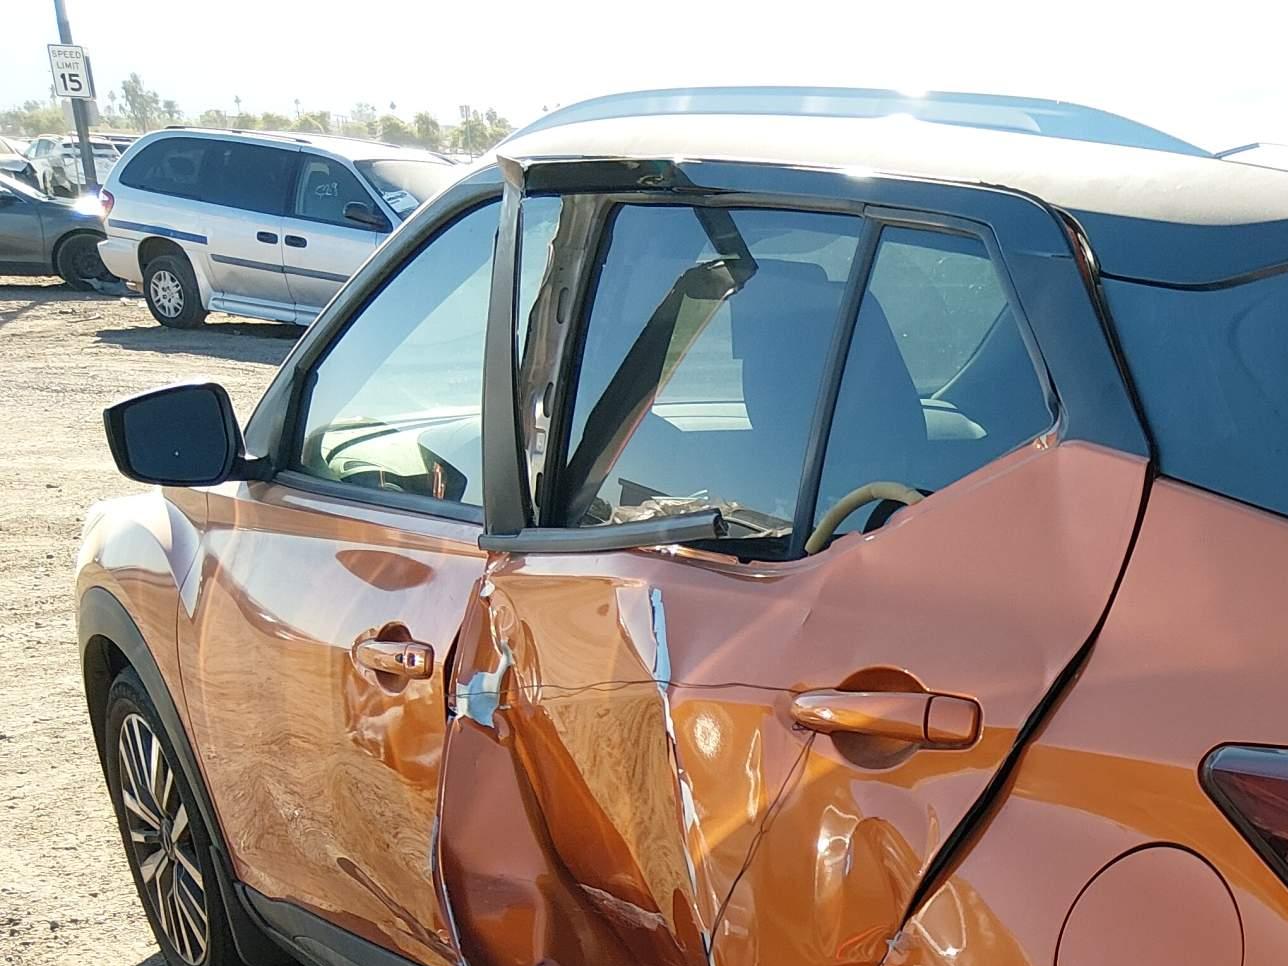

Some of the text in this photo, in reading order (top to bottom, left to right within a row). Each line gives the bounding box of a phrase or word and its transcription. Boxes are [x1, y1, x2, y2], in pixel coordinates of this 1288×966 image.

[52, 50, 81, 59] SPEED
[56, 61, 80, 70] LIMIT
[60, 72, 82, 92] 15
